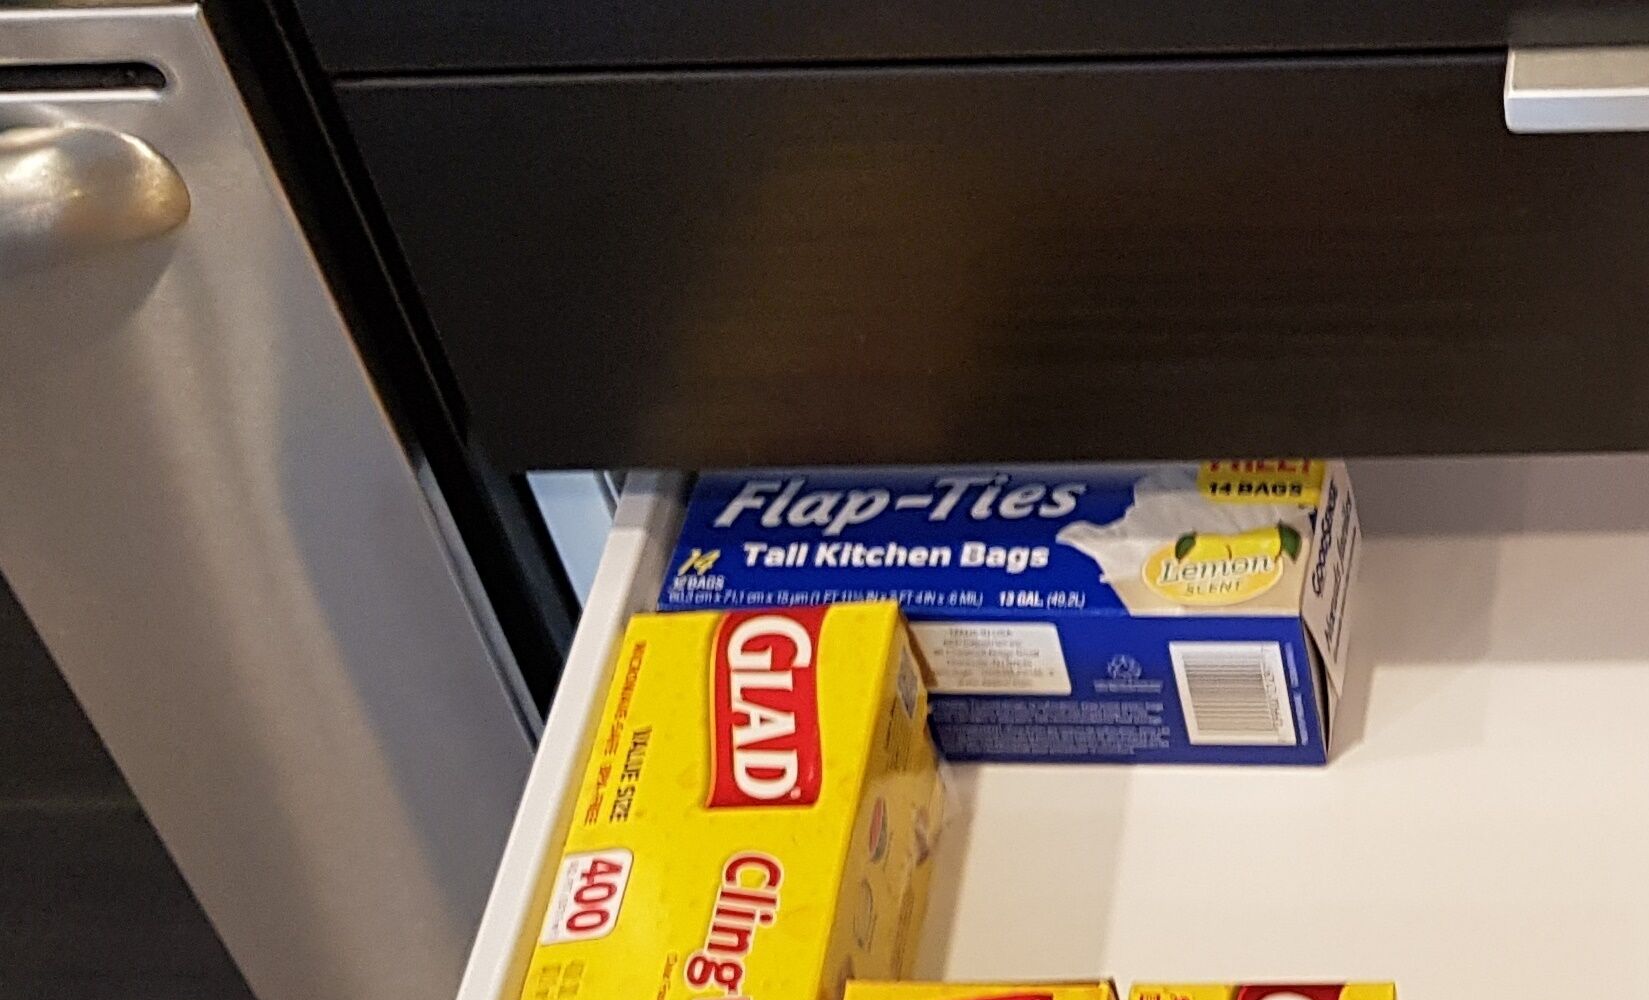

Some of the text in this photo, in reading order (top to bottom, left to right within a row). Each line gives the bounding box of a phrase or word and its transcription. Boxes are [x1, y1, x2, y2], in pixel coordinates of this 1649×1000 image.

[713, 473, 1088, 537] Flap-Ties
[1209, 483, 1302, 496] 14 BAGS
[677, 547, 721, 576] 14
[742, 540, 1050, 575] Tall Kitchen Bags
[1159, 555, 1272, 585] Lemon
[1186, 580, 1242, 595] SCENT
[727, 615, 813, 801] GLAD
[609, 724, 653, 824] VALUE SIZE
[566, 858, 622, 933] 400
